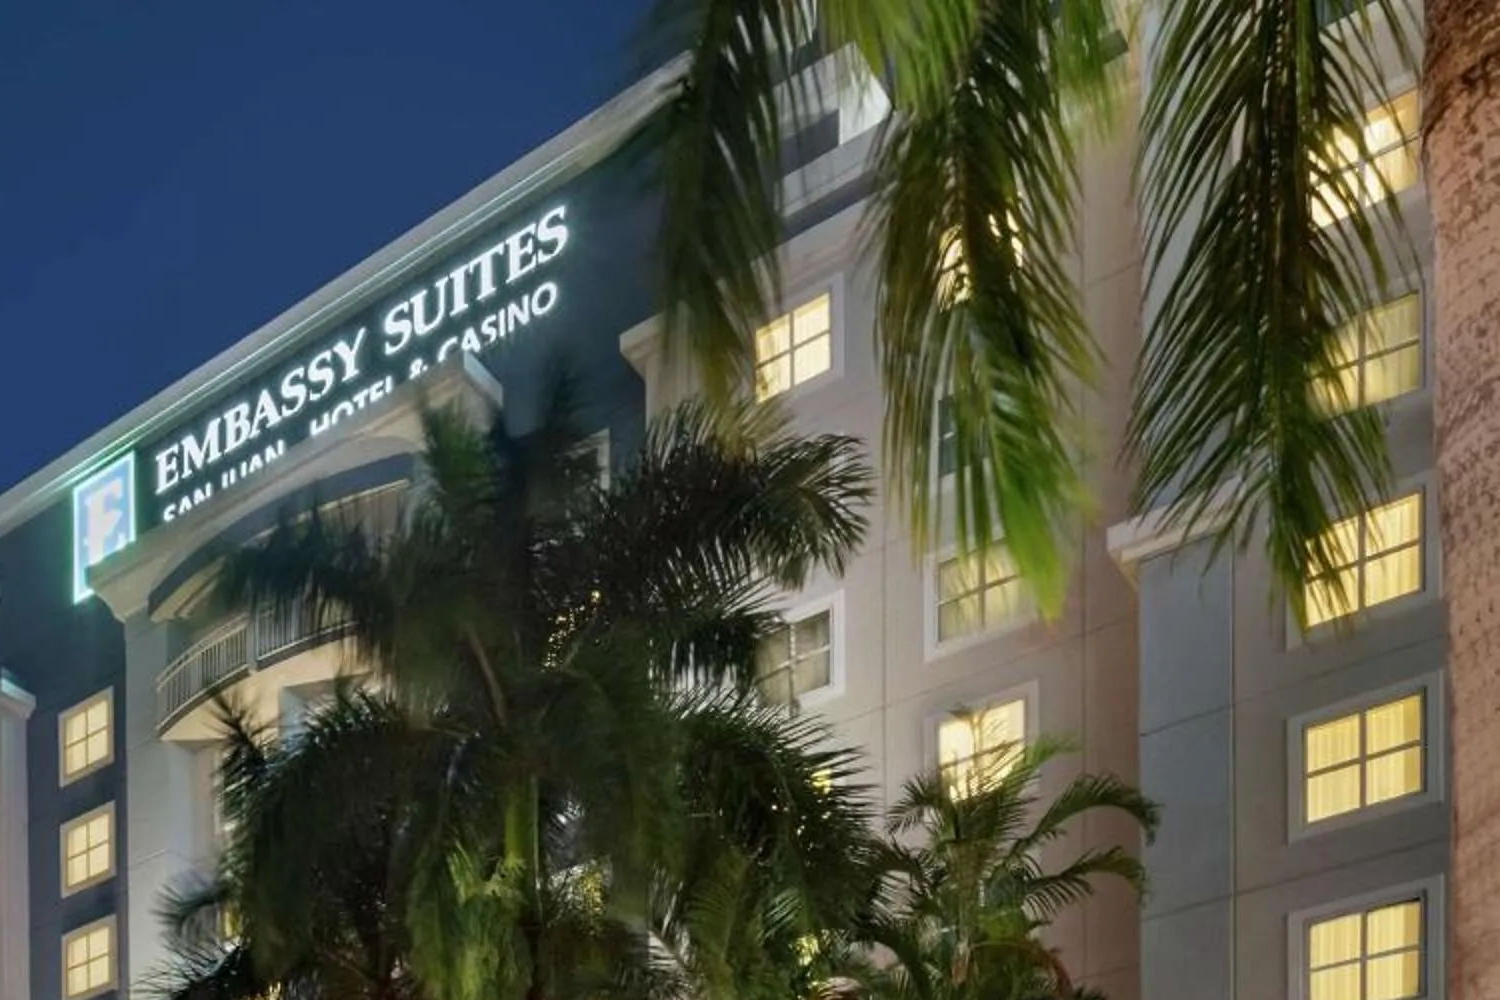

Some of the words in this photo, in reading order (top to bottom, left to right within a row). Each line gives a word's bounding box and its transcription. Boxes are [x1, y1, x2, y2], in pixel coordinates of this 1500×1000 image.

[155, 327, 366, 495] EMBASSY
[384, 205, 569, 356] SUITES
[409, 357, 428, 380] &
[437, 281, 558, 362] CASINO
